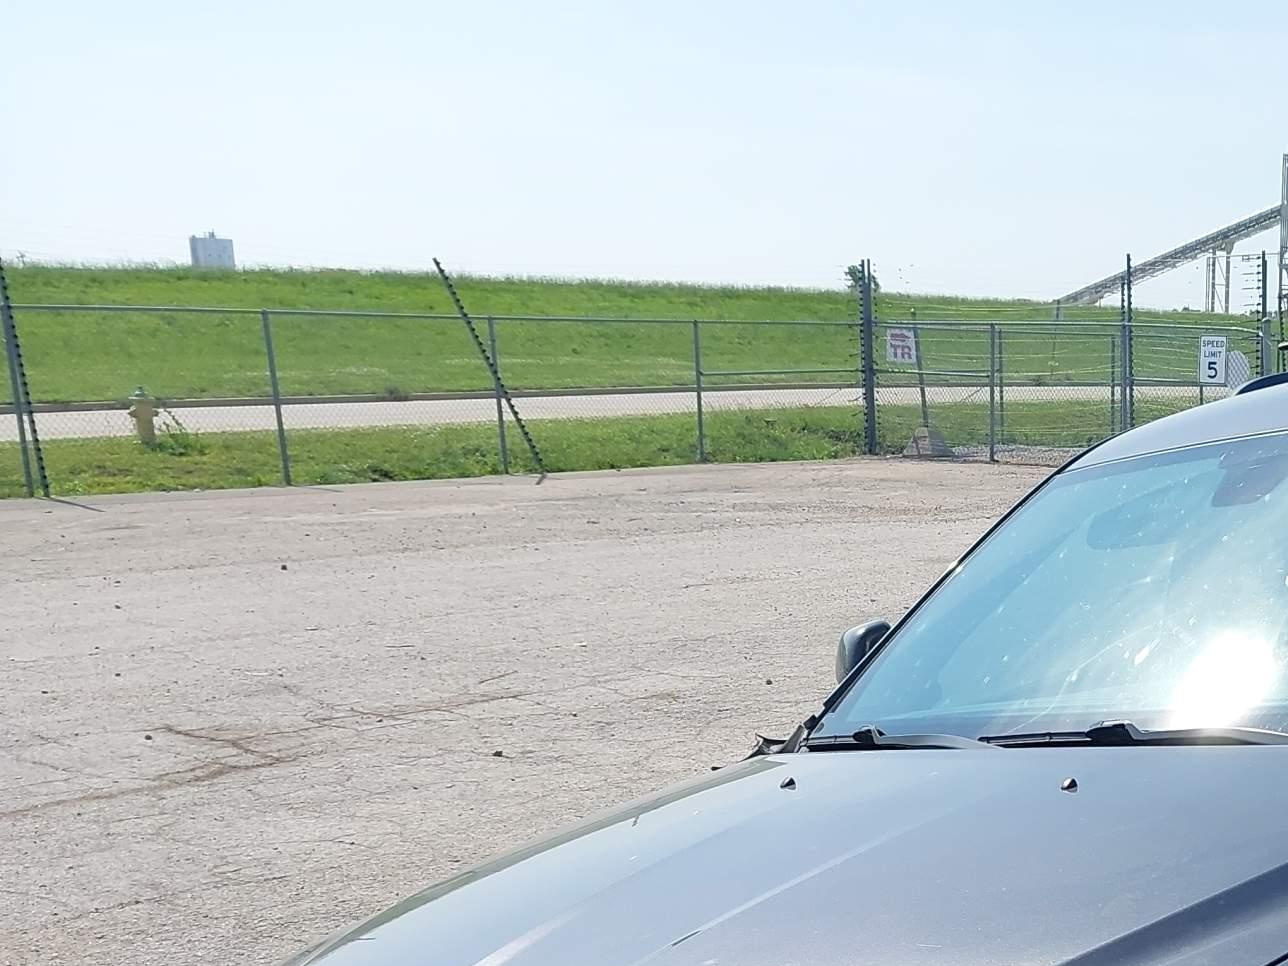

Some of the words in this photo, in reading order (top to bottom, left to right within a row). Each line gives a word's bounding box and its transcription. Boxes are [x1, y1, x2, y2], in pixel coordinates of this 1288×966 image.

[1202, 339, 1226, 348] SPEED
[1203, 350, 1223, 358] LIMIT
[1207, 361, 1218, 379] 5
